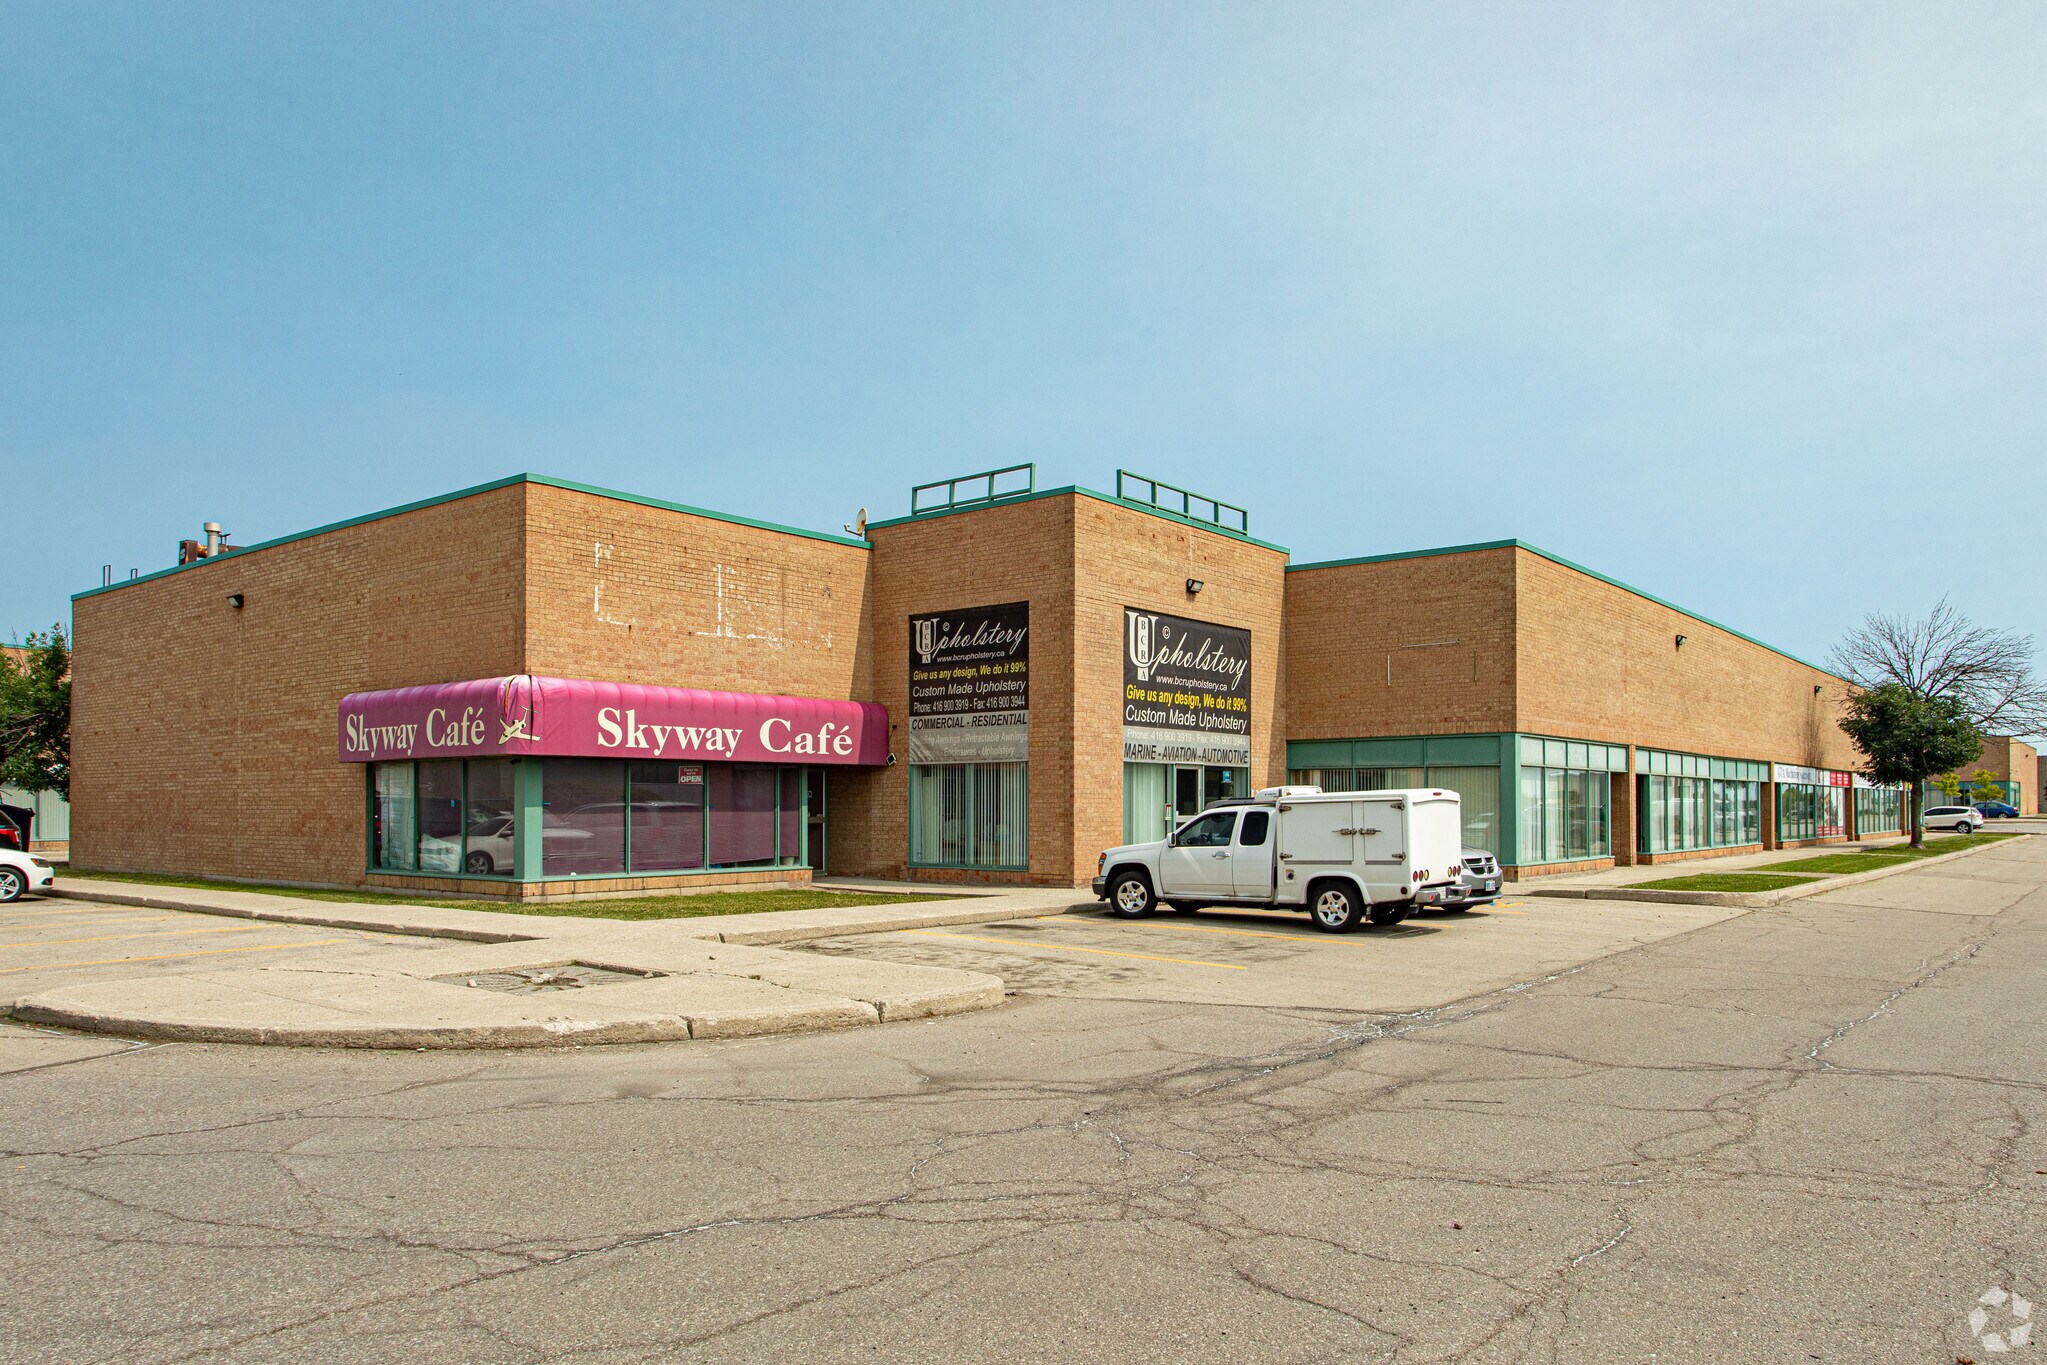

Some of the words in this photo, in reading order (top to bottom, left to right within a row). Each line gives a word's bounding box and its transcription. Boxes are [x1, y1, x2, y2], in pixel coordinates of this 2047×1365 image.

[913, 618, 1027, 659] Upholstery
[937, 651, 1005, 662] www.bcrupholstery.ca
[1125, 611, 1247, 690] Upholstery
[913, 671, 928, 681] Give
[929, 670, 938, 680] us
[939, 669, 951, 680] any
[953, 666, 978, 679] design,
[980, 664, 991, 675] We
[992, 663, 1002, 675] do
[1004, 663, 1009, 674] it
[1010, 661, 1026, 673] 99%
[912, 686, 946, 697] Custom
[947, 683, 973, 695] Made
[975, 680, 1027, 694] Upholstery
[1156, 675, 1228, 692] www.bcrupholstery.ca
[913, 702, 932, 713] Phone:
[932, 700, 943, 712] 416
[943, 700, 954, 711] 900
[986, 697, 998, 709] 416
[998, 696, 1010, 708] 900
[1126, 684, 1145, 700] Give
[1147, 690, 1157, 702] us
[1158, 691, 1173, 707] any
[1174, 690, 1201, 709] design,
[1203, 693, 1215, 708] We
[1216, 695, 1225, 710] do
[1226, 696, 1232, 710] it
[1232, 697, 1247, 712] 99%
[911, 716, 965, 730] COMMERCIAL
[971, 713, 1027, 727] RESIDENTIAL
[1125, 704, 1166, 723] Custom
[1169, 709, 1196, 726] Made
[1199, 711, 1247, 734] Upholstery
[346, 713, 418, 758] Skyway
[426, 706, 485, 748] Café
[597, 707, 743, 758] Skyway
[759, 718, 853, 756] Café
[1127, 728, 1150, 740] Phone:
[1150, 730, 1162, 740] 416
[1124, 743, 1157, 760] MARINE
[1161, 745, 1197, 762] AVIATION
[680, 775, 702, 783] OPEN
